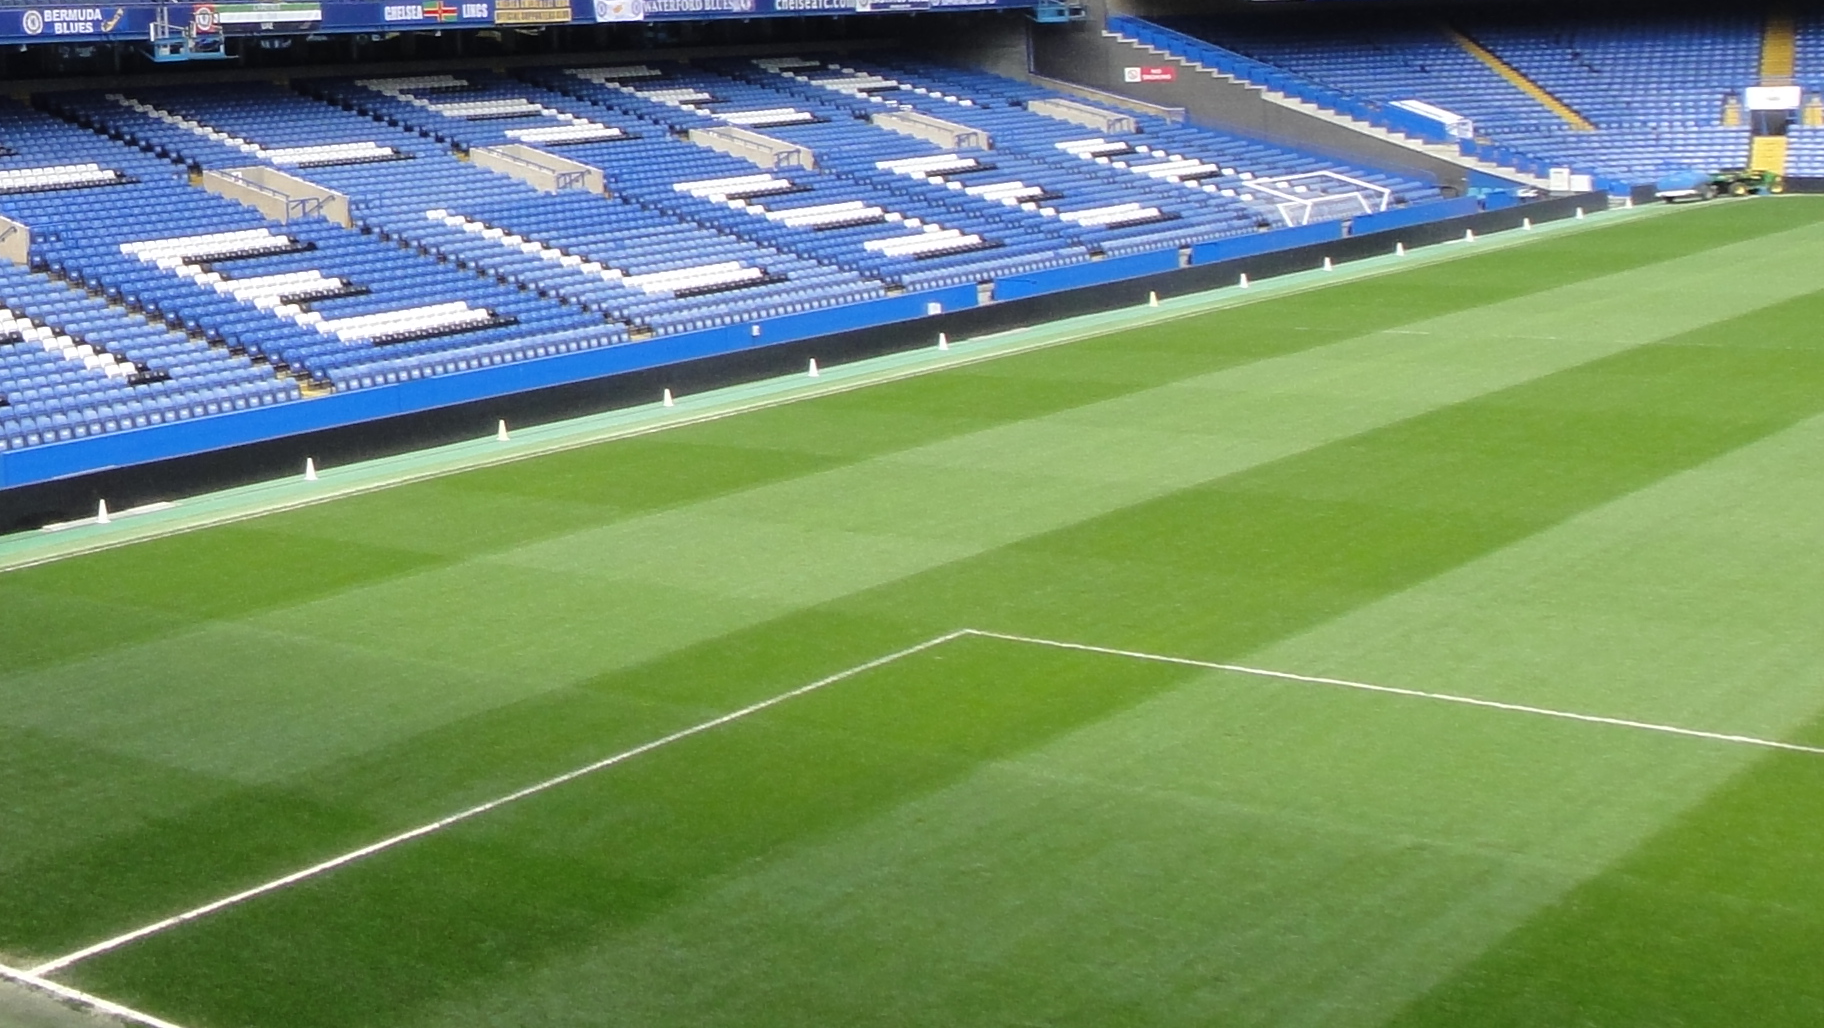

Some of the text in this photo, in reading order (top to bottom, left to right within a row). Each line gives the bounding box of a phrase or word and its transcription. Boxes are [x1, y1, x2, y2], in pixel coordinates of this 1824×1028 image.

[43, 8, 102, 22] BERMUDA
[384, 5, 423, 21] CHELSEA
[54, 22, 93, 34] BLUES
